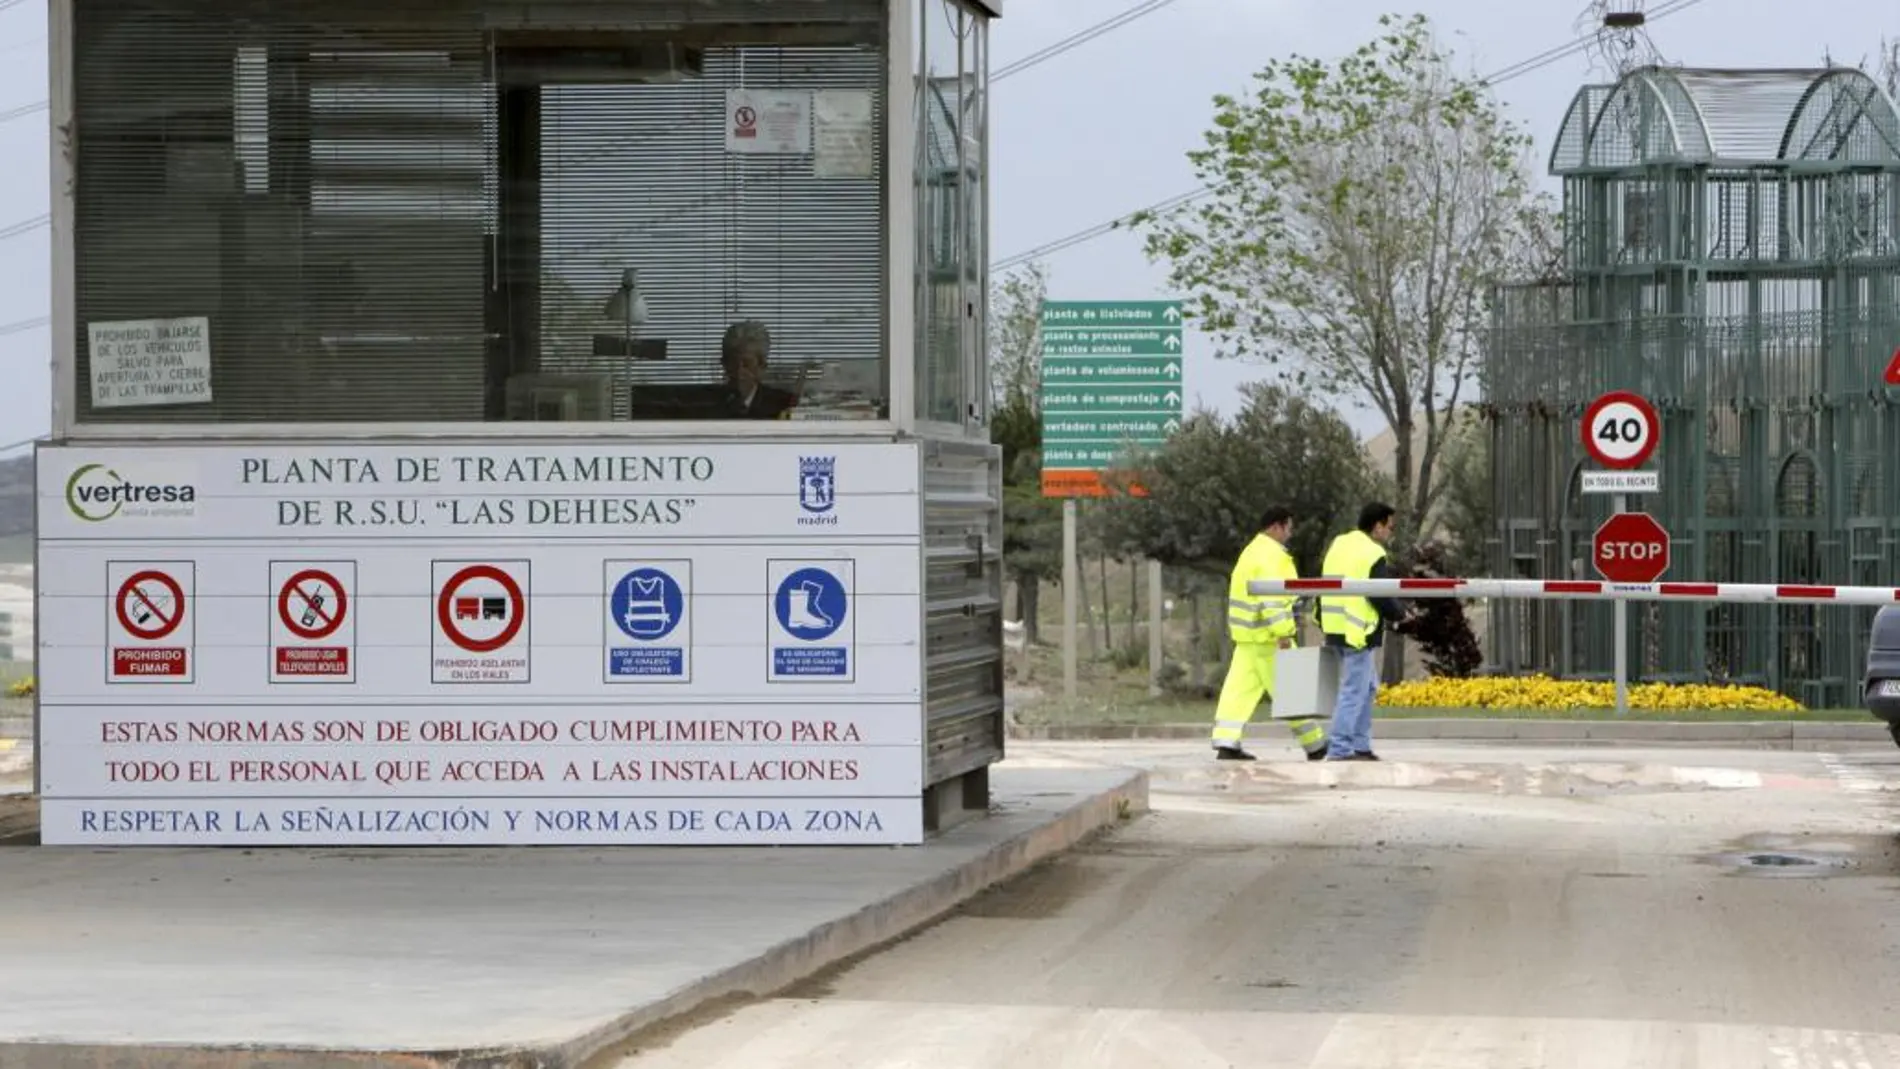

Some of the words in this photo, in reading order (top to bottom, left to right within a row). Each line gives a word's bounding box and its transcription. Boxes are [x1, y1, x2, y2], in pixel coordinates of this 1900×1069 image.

[1044, 309, 1077, 320] planta
[1083, 309, 1095, 319] de
[1044, 332, 1074, 342] planta
[1077, 332, 1089, 340] de
[97, 344, 111, 356] DE
[118, 343, 137, 356] LOS
[1044, 344, 1055, 353] de
[156, 369, 163, 381] Y
[1044, 364, 1077, 377] planta
[1081, 365, 1093, 375] de
[99, 386, 111, 398] DE
[119, 385, 138, 397] LAS
[1044, 393, 1077, 405] planta
[1082, 393, 1094, 403] de
[1598, 418, 1642, 443] 40
[242, 458, 380, 484] PLANTA
[396, 457, 440, 483] DE
[452, 456, 714, 482] TRATAMIENTO
[77, 482, 195, 503] vertresa
[277, 500, 322, 526] DE
[335, 499, 425, 526] R.S.U.
[797, 514, 838, 525] madrid
[1601, 541, 1662, 560] STOP
[117, 650, 182, 661] PROHIBIDO
[130, 662, 170, 673] FUMAR
[102, 721, 178, 743] ESTAS
[187, 720, 305, 742] NORMAS
[313, 720, 364, 742] SON
[376, 720, 411, 742] DE
[419, 720, 558, 742] OBLIGADO
[569, 720, 782, 742] CUMPLIMIENTO
[791, 720, 861, 742] PARA
[104, 760, 180, 782] TODO
[188, 760, 220, 782] EL
[230, 760, 367, 782] PERSONAL
[375, 760, 431, 786] QUE
[441, 760, 545, 781] ACCEDA
[563, 761, 580, 781] A
[593, 760, 642, 781] LAS
[651, 760, 859, 781] INSTALACIONES
[81, 810, 222, 832] RESPETAR
[235, 810, 271, 832] LA
[281, 806, 489, 832] SEÑALIZACIÓN
[504, 810, 522, 831] Y
[535, 810, 658, 831] NORMAS
[668, 810, 703, 831] DE
[714, 810, 792, 831] CADA
[804, 810, 883, 831] ZONA
